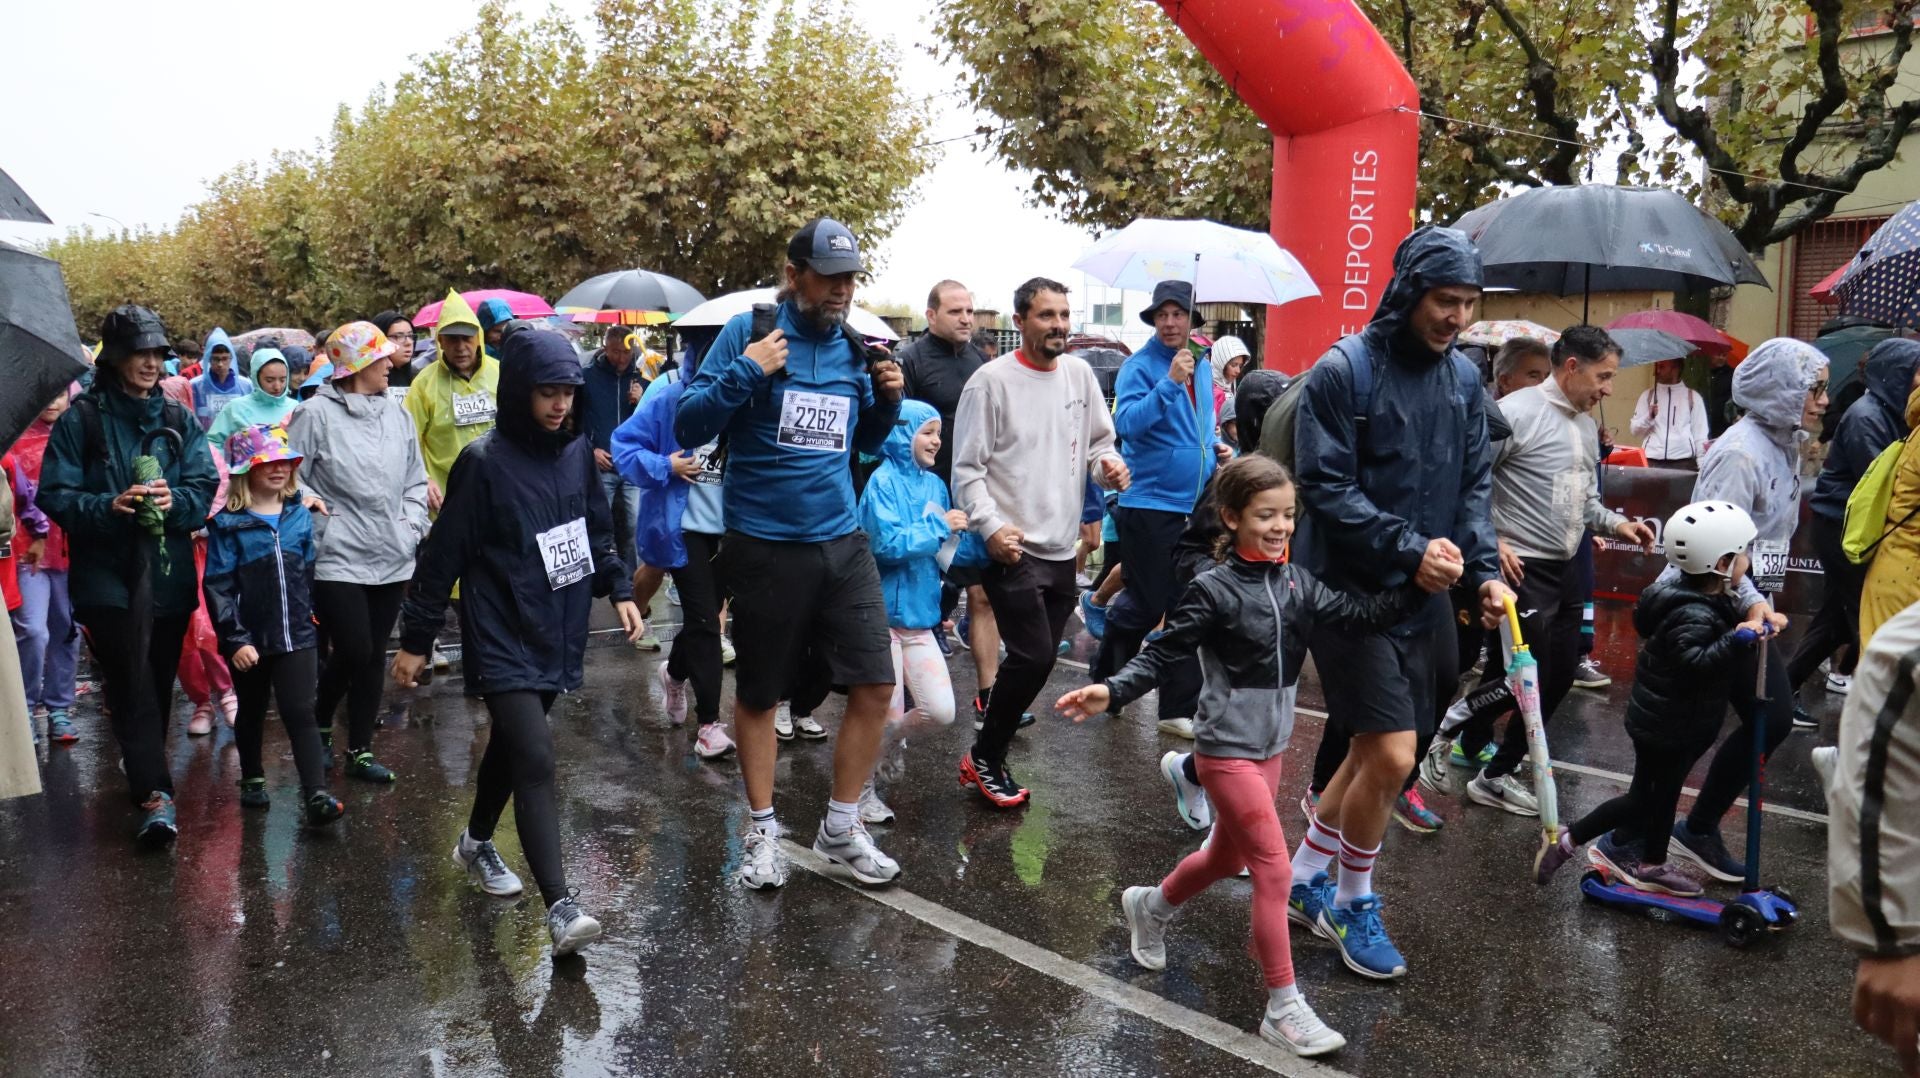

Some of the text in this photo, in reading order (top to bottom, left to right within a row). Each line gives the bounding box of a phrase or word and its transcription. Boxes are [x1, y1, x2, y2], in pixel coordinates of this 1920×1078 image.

[1342, 150, 1378, 310] DEPORTES
[456, 398, 488, 415] 3942
[793, 406, 837, 432] 2262
[806, 437, 835, 446] HYUNDAI
[549, 537, 582, 569] 256
